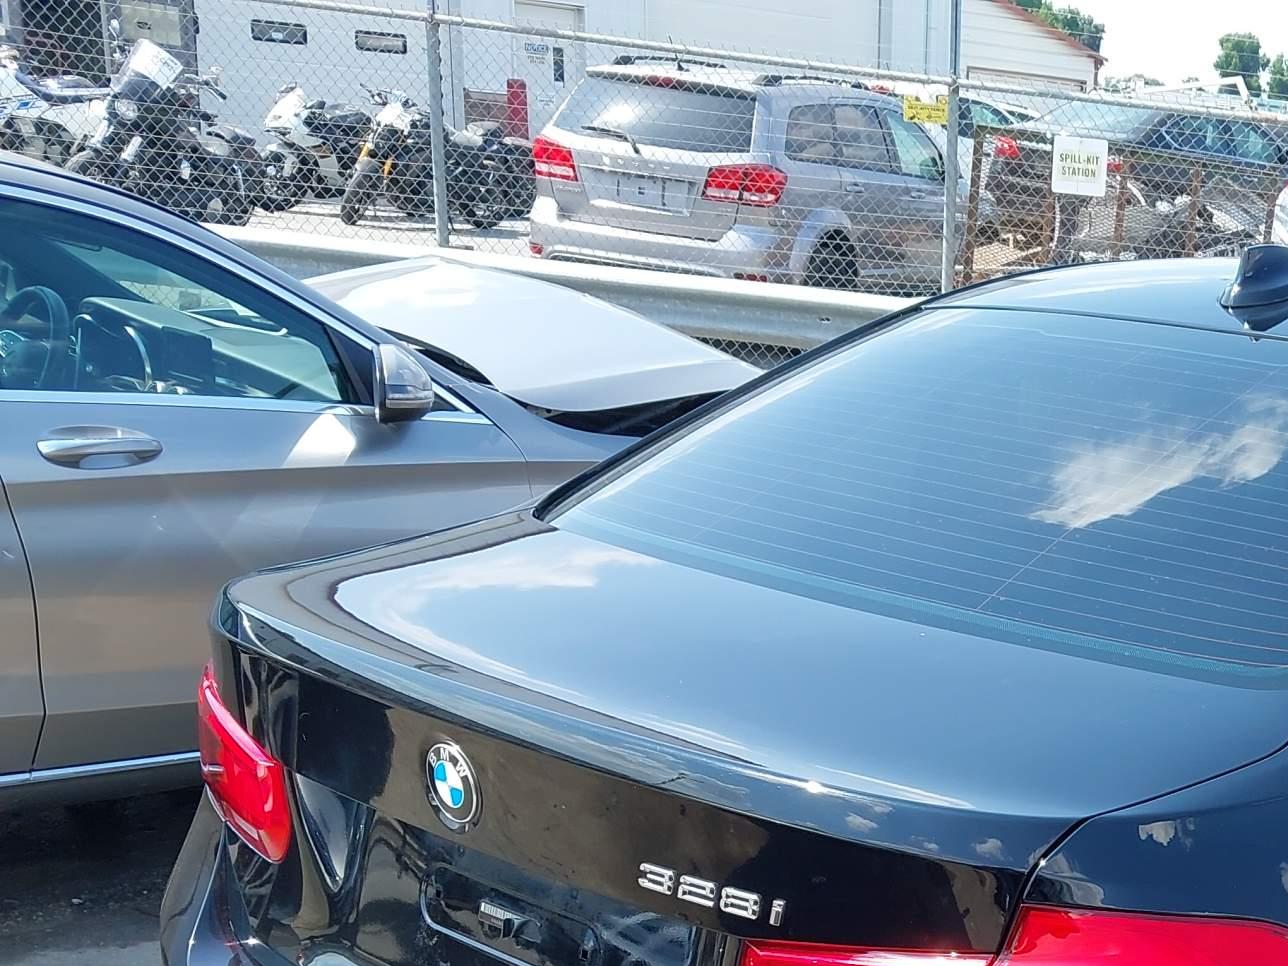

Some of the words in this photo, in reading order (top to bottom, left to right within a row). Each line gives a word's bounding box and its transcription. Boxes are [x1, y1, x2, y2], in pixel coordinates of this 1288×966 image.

[1059, 152, 1099, 166] SPILL-KIT
[1061, 165, 1096, 178] STATION
[429, 747, 468, 778] BMW
[637, 862, 786, 927] 328i
